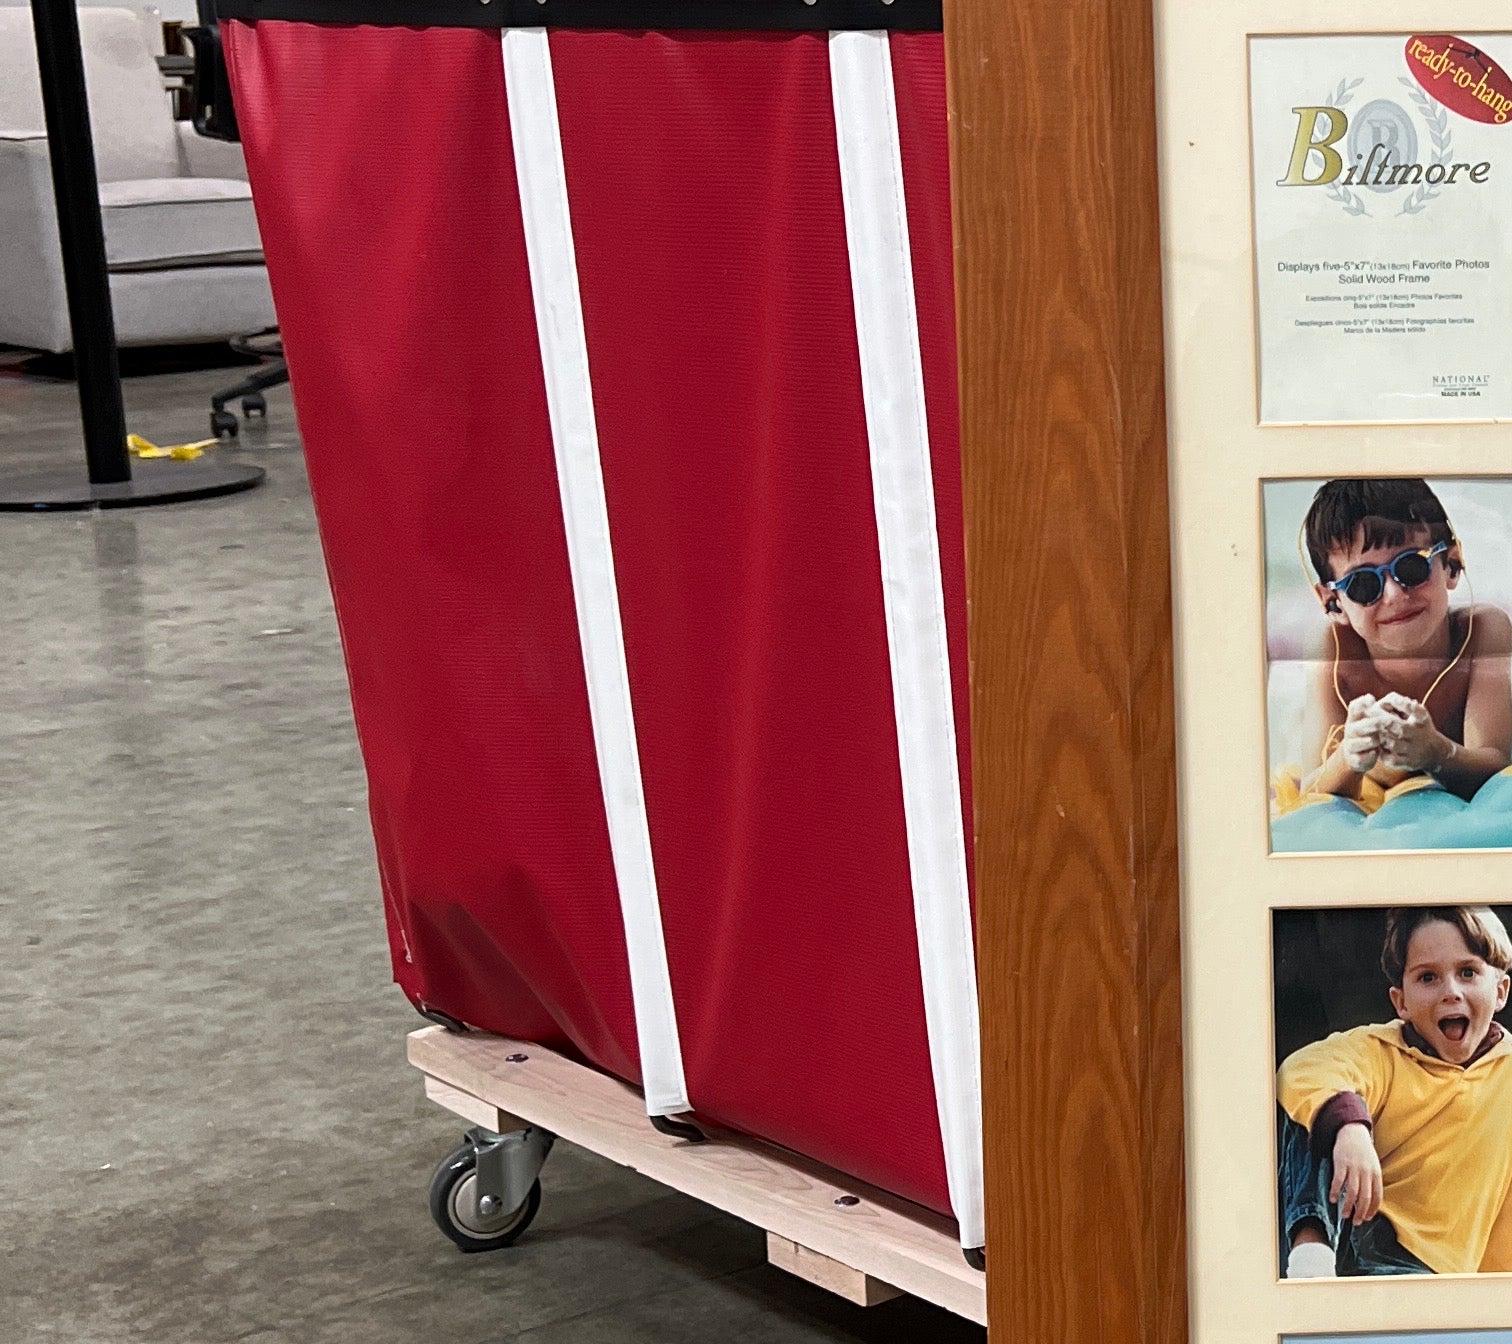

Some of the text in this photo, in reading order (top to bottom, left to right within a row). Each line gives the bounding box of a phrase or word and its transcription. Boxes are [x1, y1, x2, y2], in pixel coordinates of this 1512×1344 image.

[1276, 106, 1491, 186] Biltmore
[1277, 261, 1320, 273] Displays
[1412, 260, 1452, 270] Favorite
[1455, 259, 1490, 269] Photos
[1338, 273, 1430, 284] Solid Wood Frame
